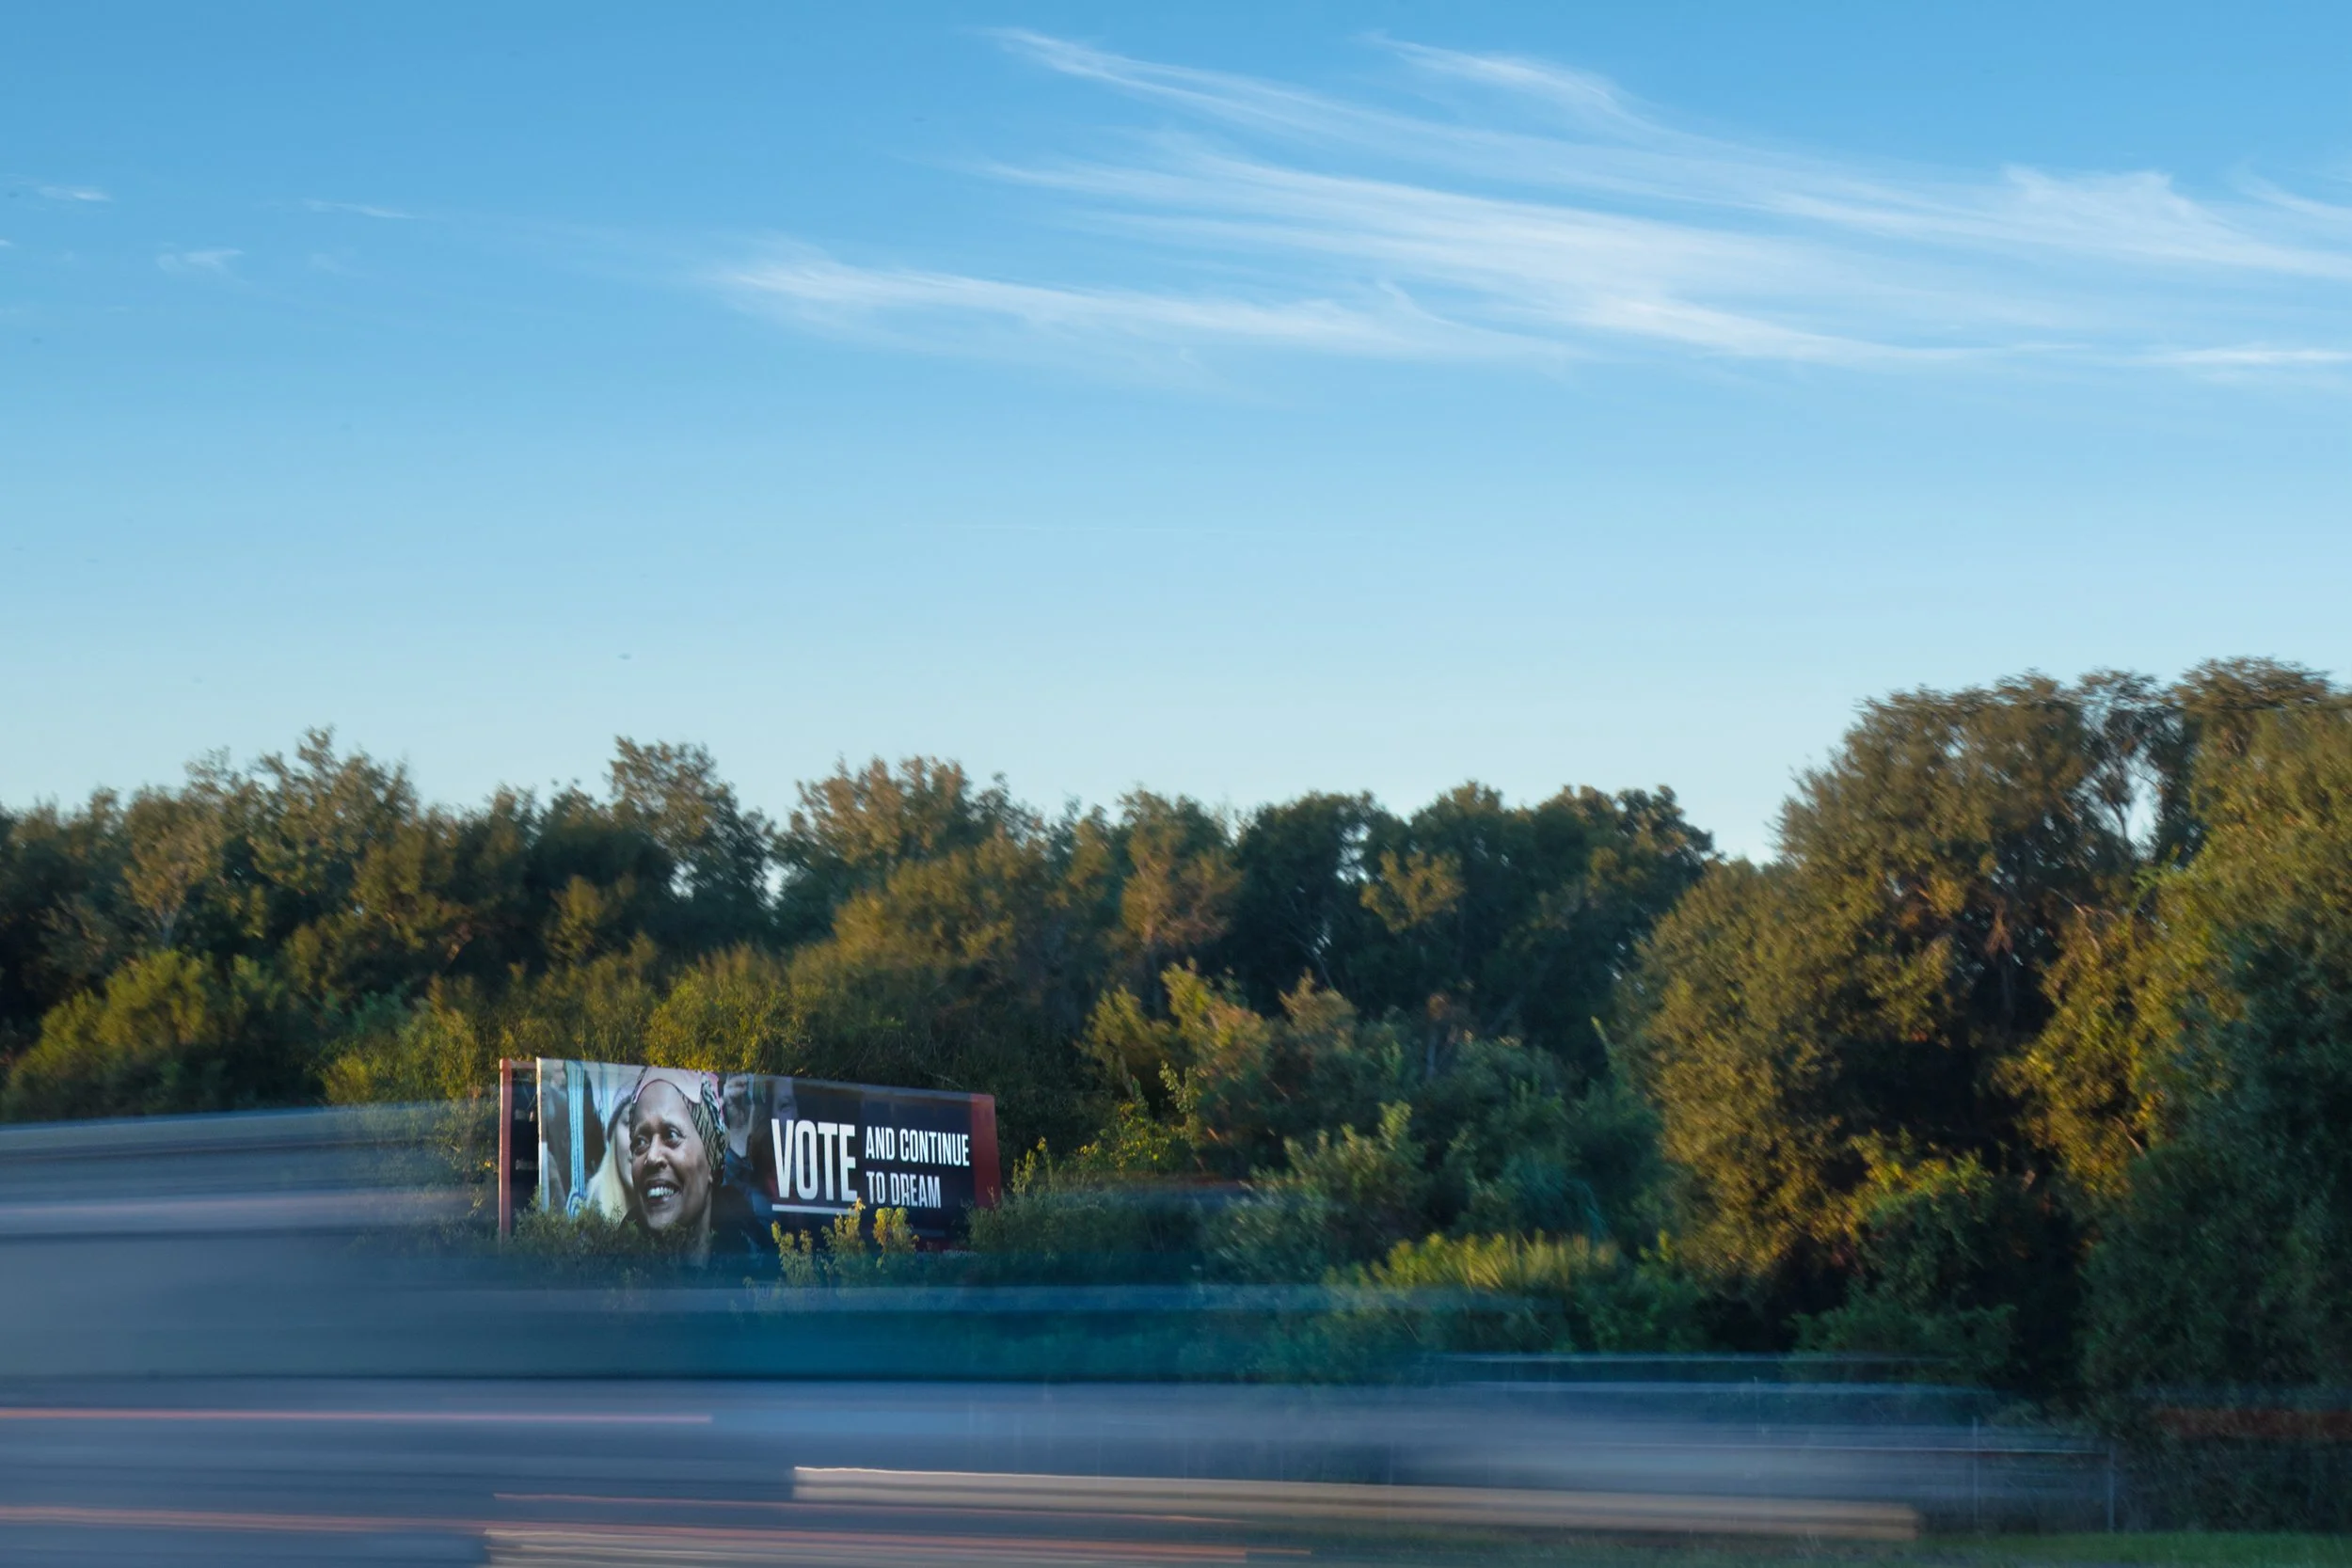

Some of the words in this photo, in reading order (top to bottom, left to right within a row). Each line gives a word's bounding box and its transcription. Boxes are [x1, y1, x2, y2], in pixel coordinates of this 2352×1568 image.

[771, 1118, 858, 1202] VOTE
[866, 1126, 895, 1160] AND
[899, 1129, 970, 1166] CONTINUE
[866, 1171, 886, 1204] TO
[890, 1172, 941, 1209] DREAM
